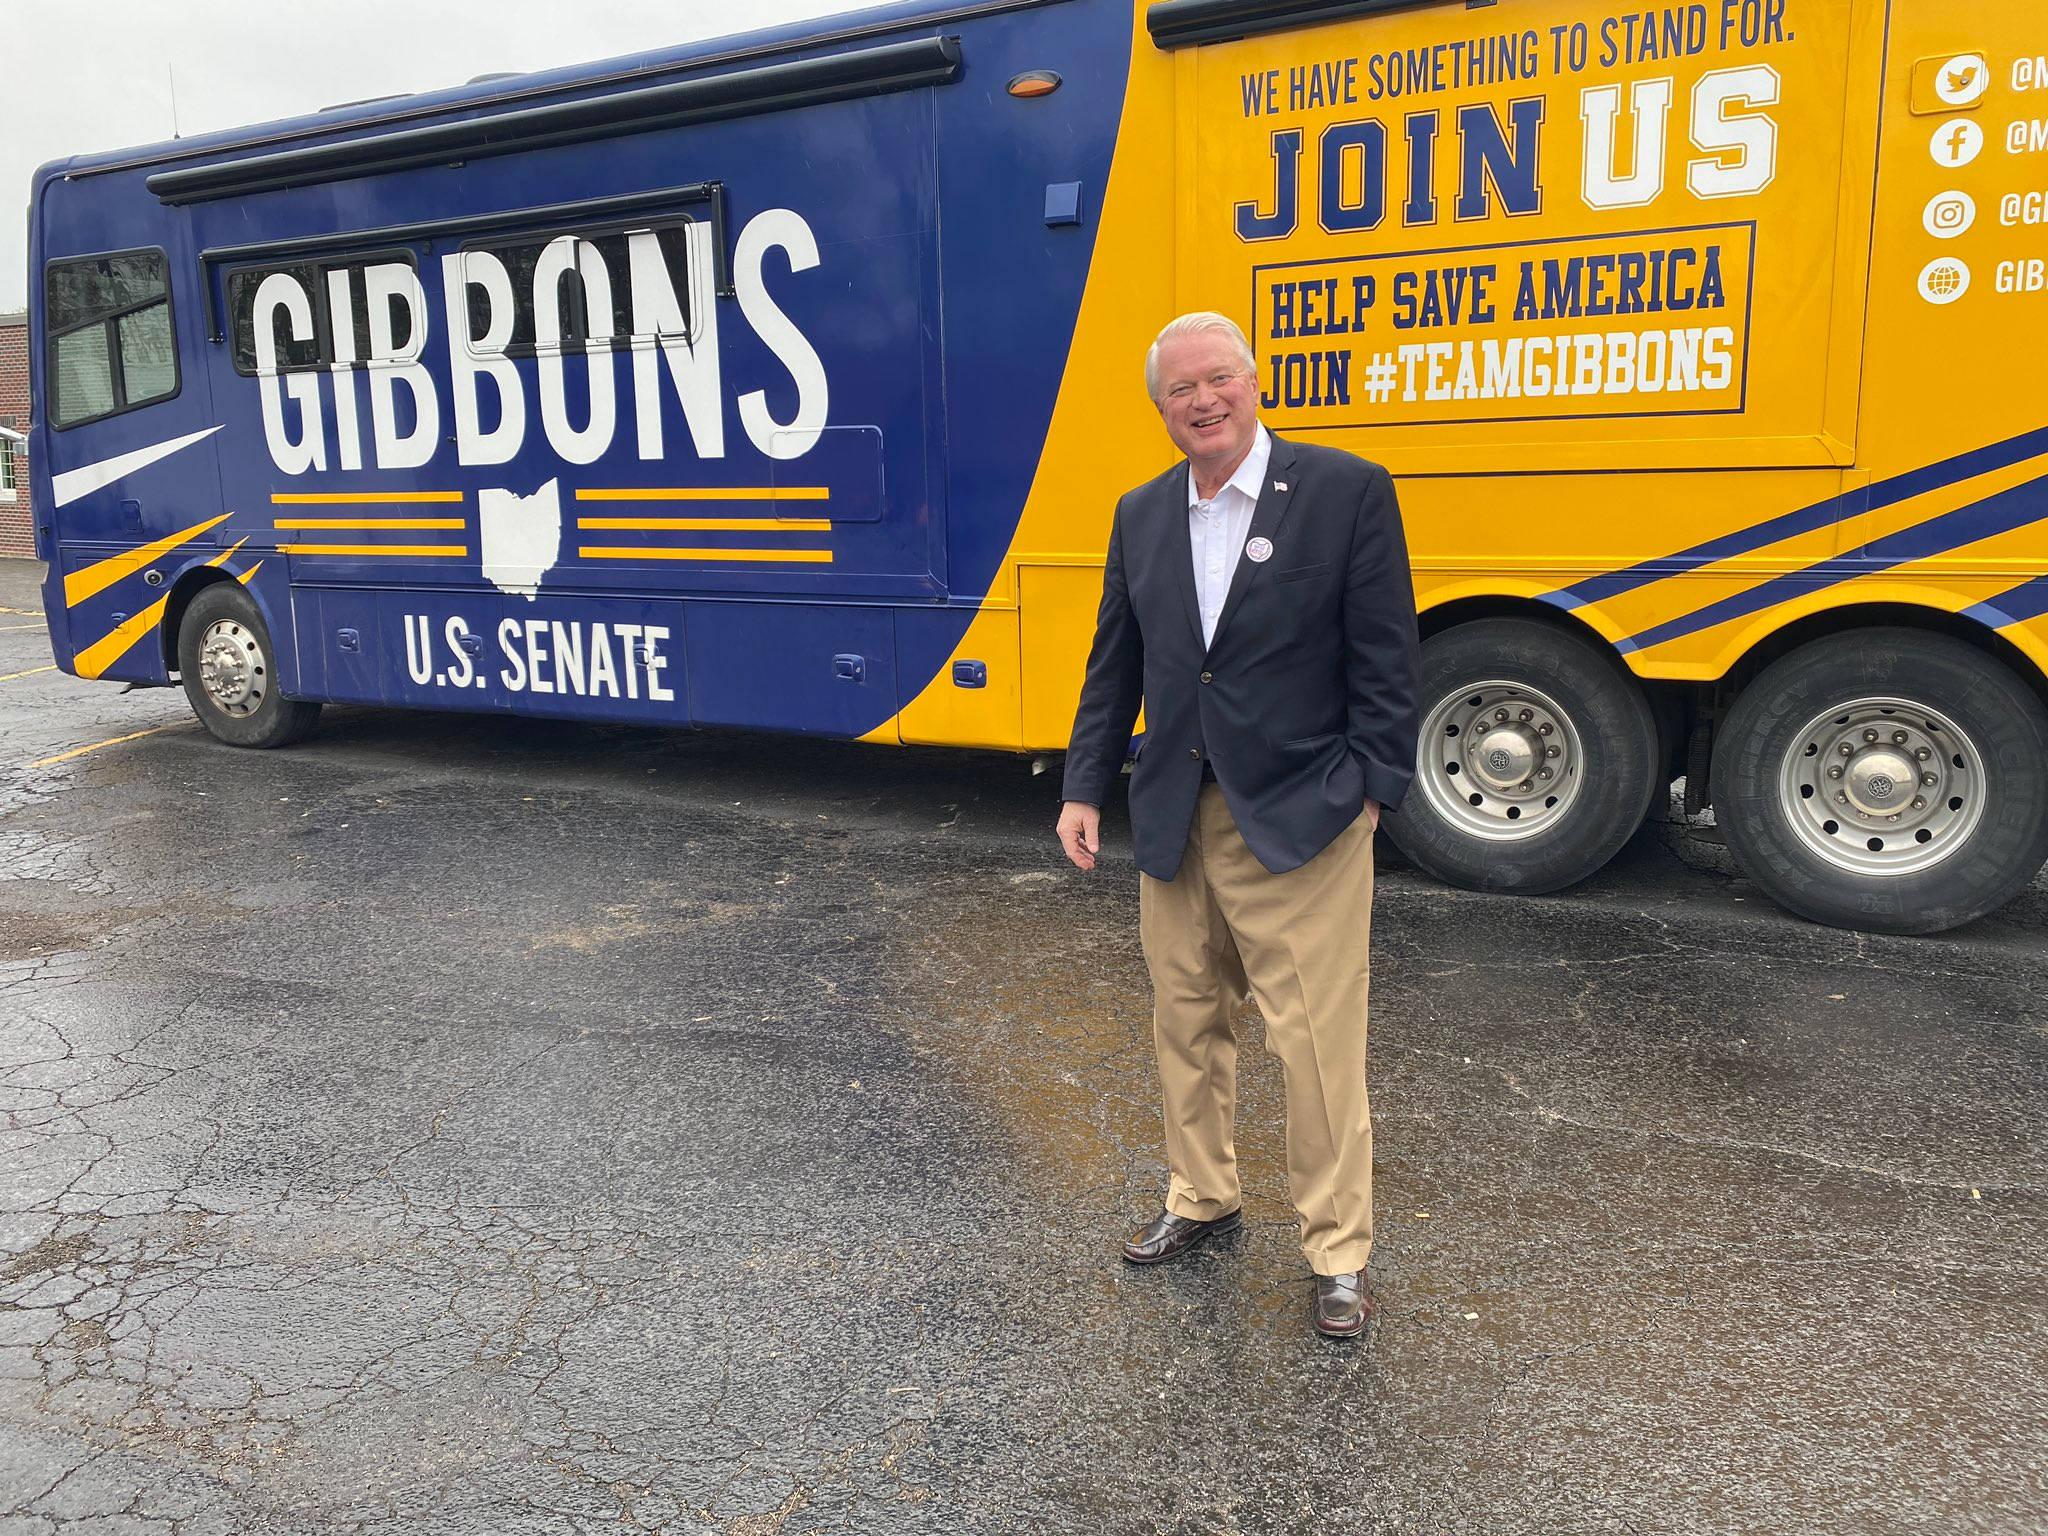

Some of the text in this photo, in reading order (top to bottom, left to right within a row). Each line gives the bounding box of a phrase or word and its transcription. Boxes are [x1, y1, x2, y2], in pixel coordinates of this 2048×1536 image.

[1240, 0, 1796, 117] WE HAVE SOMETHING TO STAND FOR.
[1234, 62, 1781, 243] JOIN US
[1270, 246, 1726, 339] HELP SAVE AMERICA
[1995, 259, 2048, 293] GIB
[253, 208, 829, 475] GIBBONS
[1261, 326, 1734, 409] JOIN #TEAMGIBBONS
[404, 614, 674, 701] U.S. SENATE
